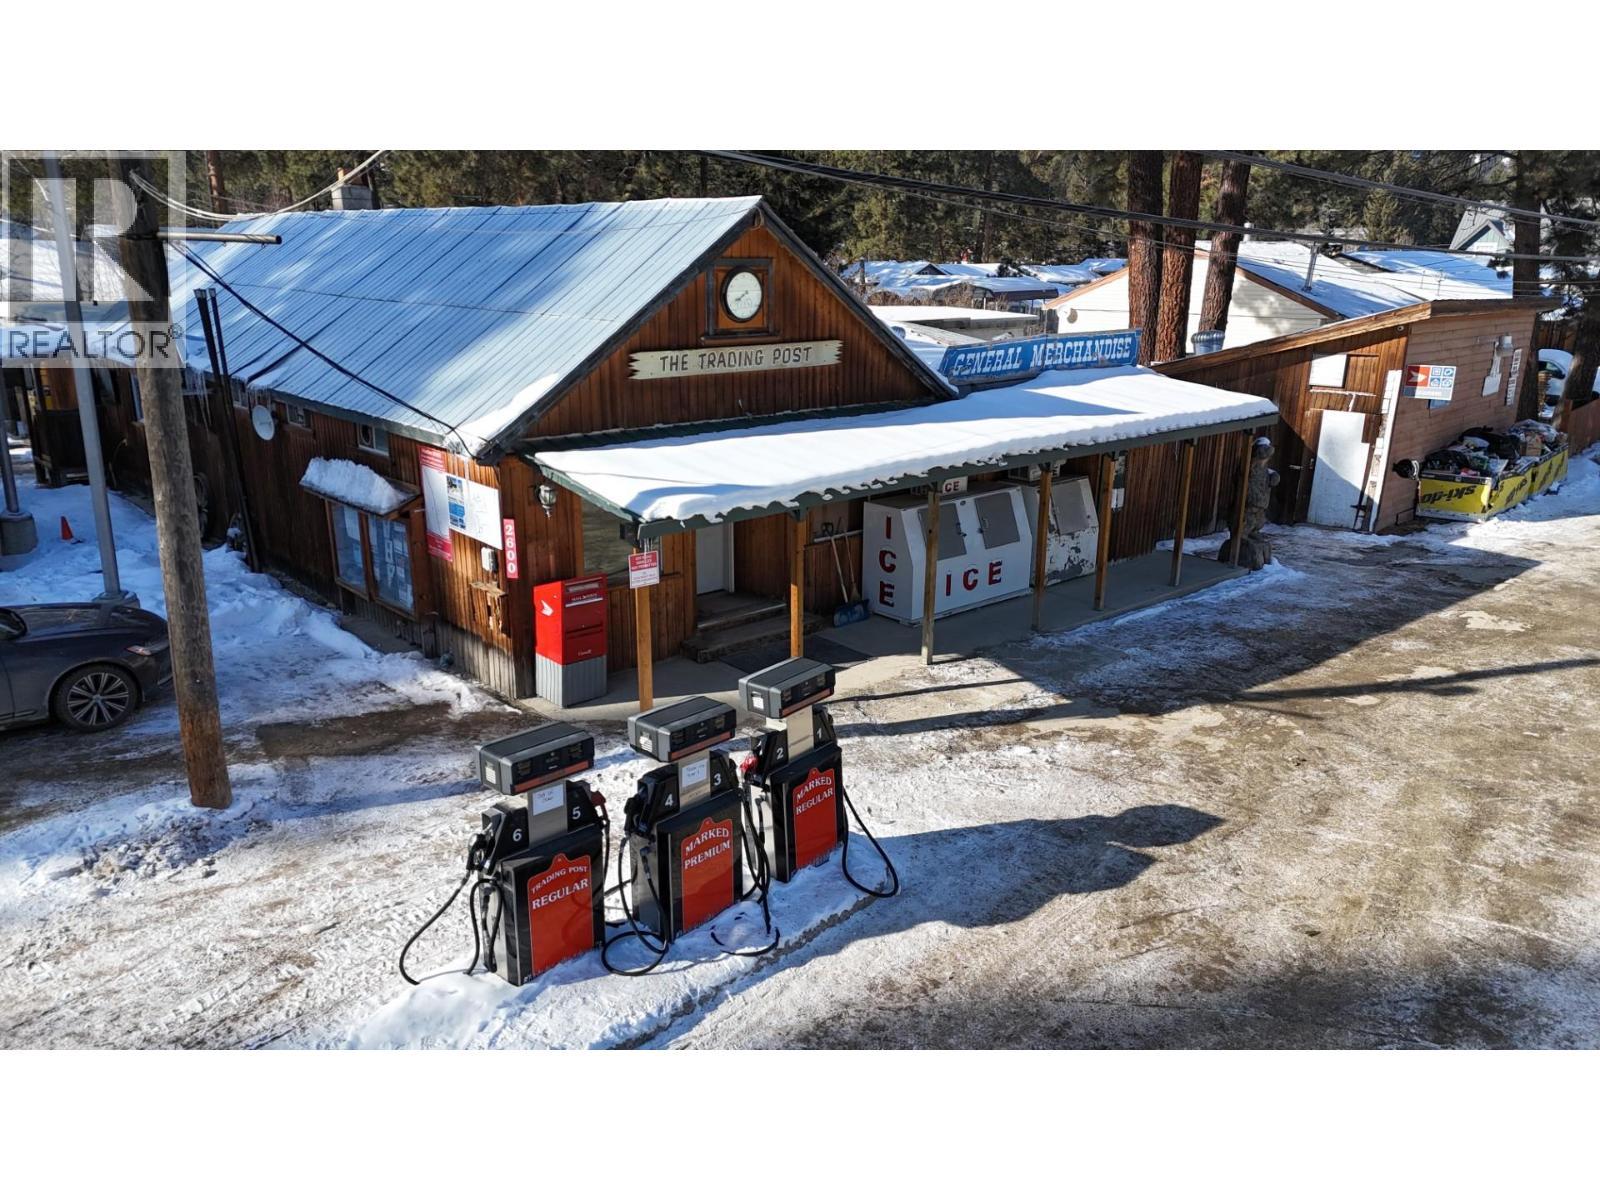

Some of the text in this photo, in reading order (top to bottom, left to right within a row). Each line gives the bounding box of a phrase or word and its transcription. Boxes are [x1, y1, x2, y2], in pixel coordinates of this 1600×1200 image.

[660, 346, 812, 371] THE TRADING POST
[952, 336, 1132, 376] GENERAL MERCHANDISE
[505, 525, 516, 573] 2600
[878, 516, 897, 607] ICE
[945, 560, 1003, 597] ICE
[816, 728, 822, 739] 1
[776, 748, 784, 760] 2
[713, 773, 722, 786] 3
[796, 776, 832, 803] MARKED
[572, 806, 581, 819] 5
[664, 794, 674, 807] 4
[795, 787, 833, 815] REGULAR
[512, 829, 522, 842] 6
[685, 828, 729, 856] MARKED
[684, 840, 731, 869] PREMIUM
[531, 865, 588, 894] TRADING POST
[532, 878, 589, 910] REGULAR
